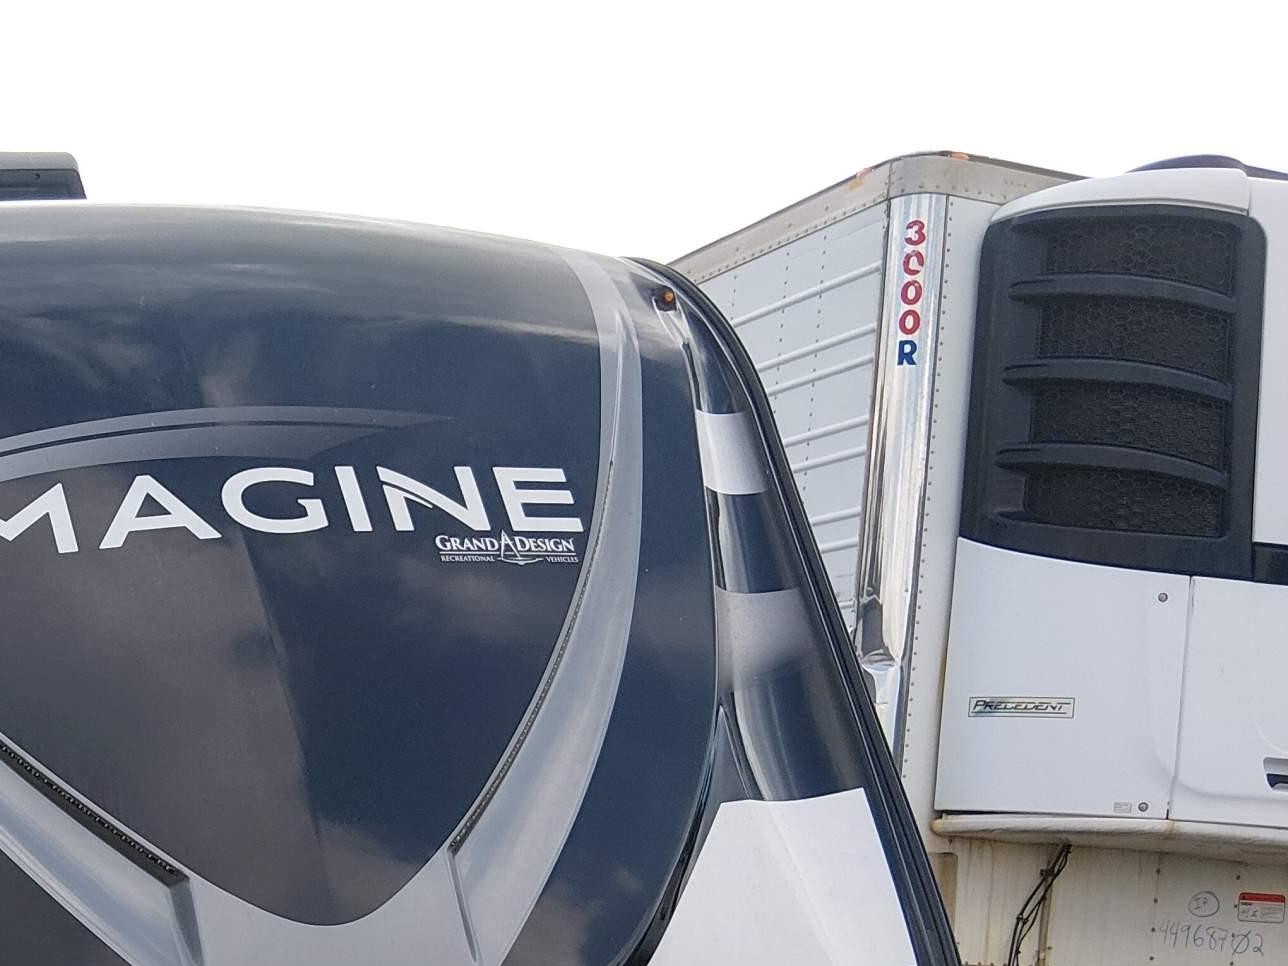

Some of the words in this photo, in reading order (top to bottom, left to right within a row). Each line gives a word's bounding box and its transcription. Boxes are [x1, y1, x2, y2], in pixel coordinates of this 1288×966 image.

[897, 219, 926, 366] 3000R
[435, 535, 499, 551] GRAND
[513, 536, 575, 552] DESIGN
[441, 555, 496, 563] RECREATIONAL
